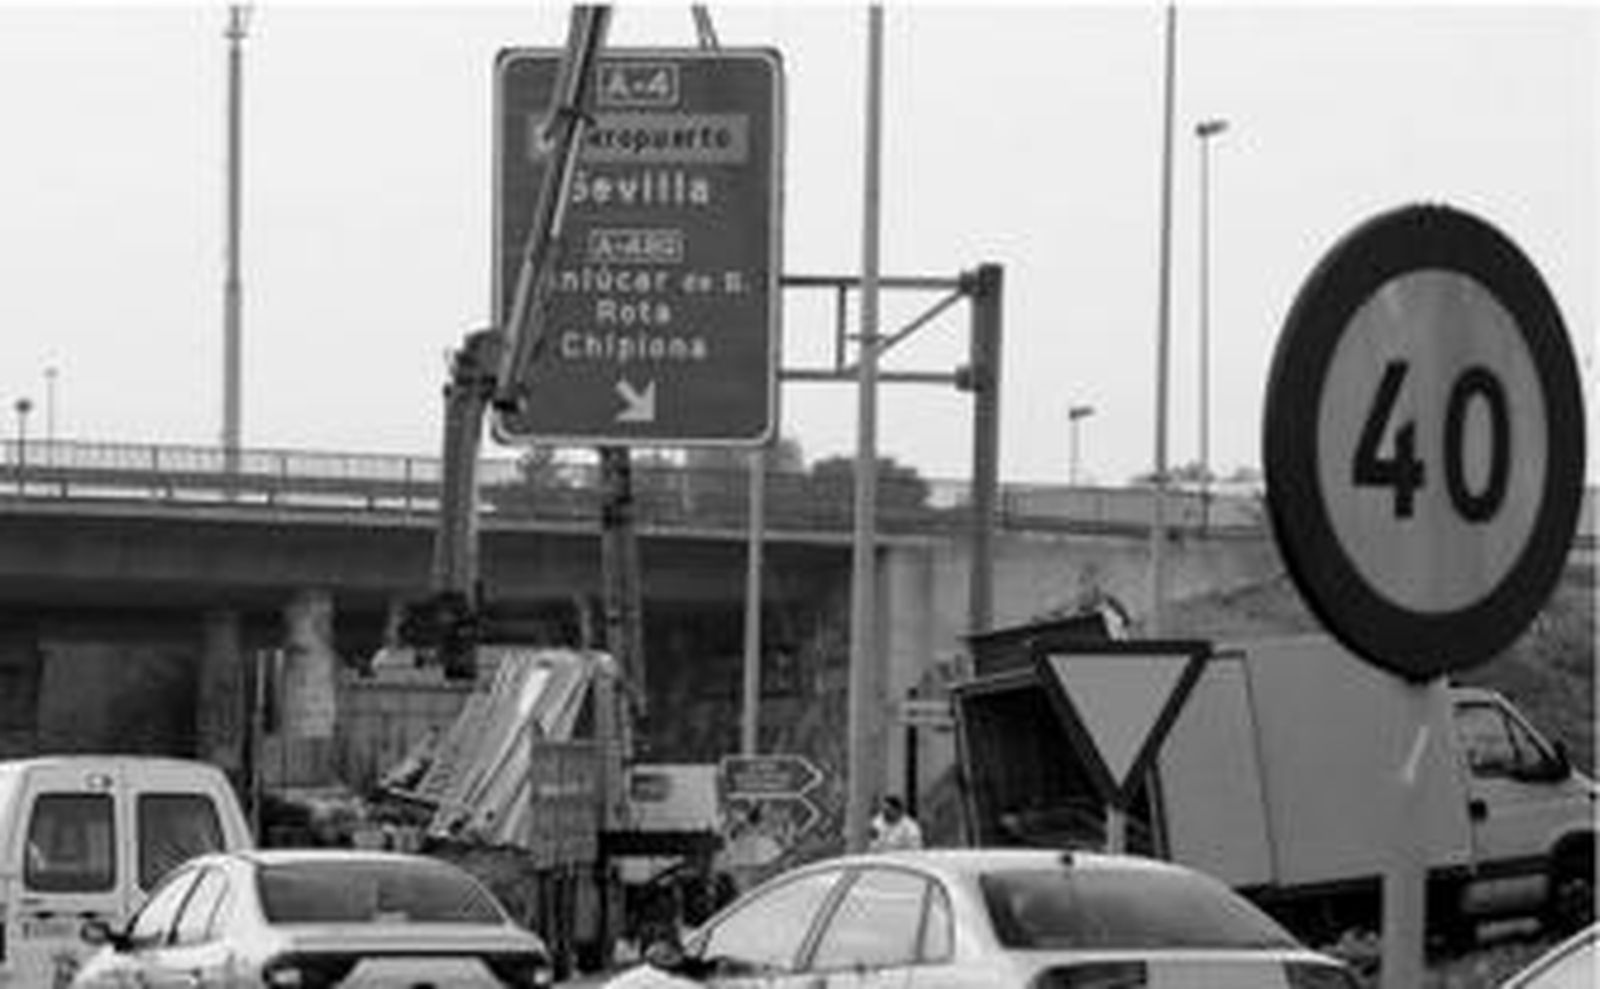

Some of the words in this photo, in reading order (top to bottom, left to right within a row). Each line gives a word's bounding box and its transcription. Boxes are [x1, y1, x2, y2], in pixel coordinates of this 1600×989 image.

[608, 68, 669, 97] A-4
[571, 168, 709, 205] Sevilla
[597, 299, 671, 325] Rota
[562, 331, 707, 362] Chipiona
[1352, 360, 1512, 525] 40
